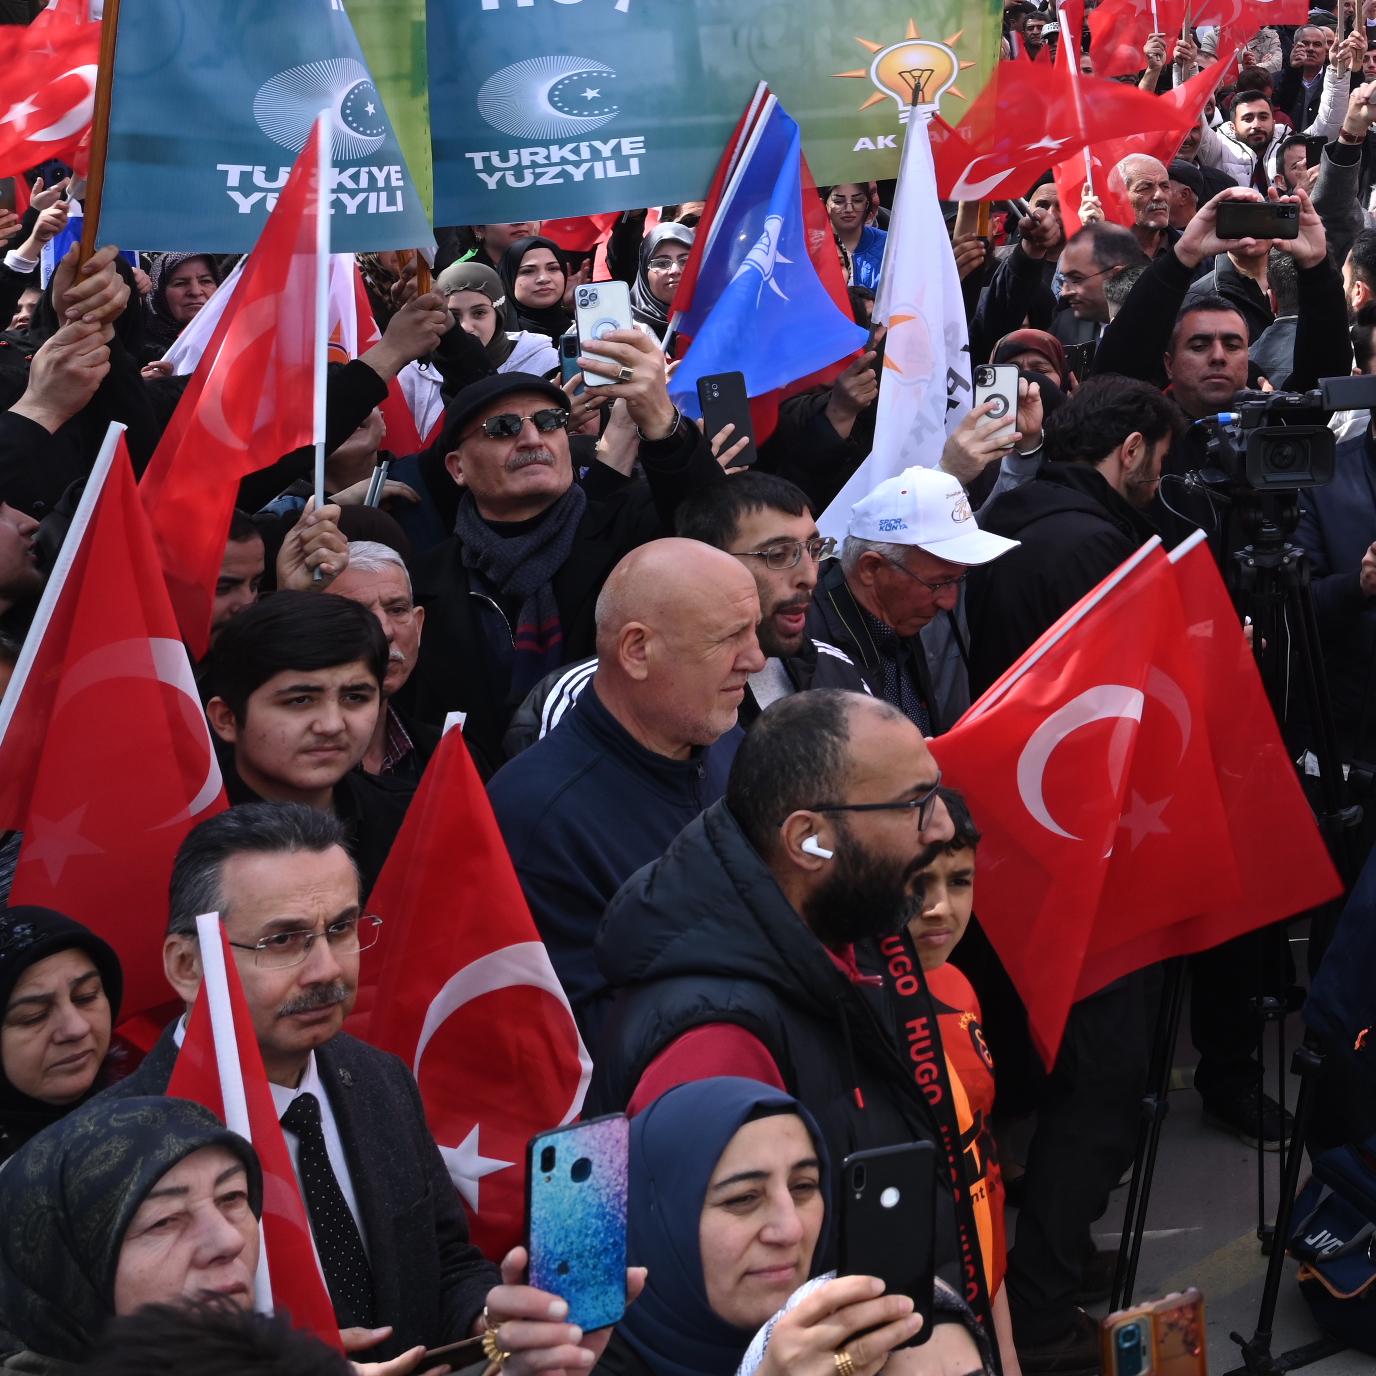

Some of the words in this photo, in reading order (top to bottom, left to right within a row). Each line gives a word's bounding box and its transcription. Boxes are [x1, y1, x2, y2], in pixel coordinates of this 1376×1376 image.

[853, 135, 897, 151] AK
[217, 164, 404, 188] TÜKİYE
[880, 935, 919, 996] UGO
[905, 1016, 943, 1105] HUGO
[1304, 1229, 1344, 1255] JVC
